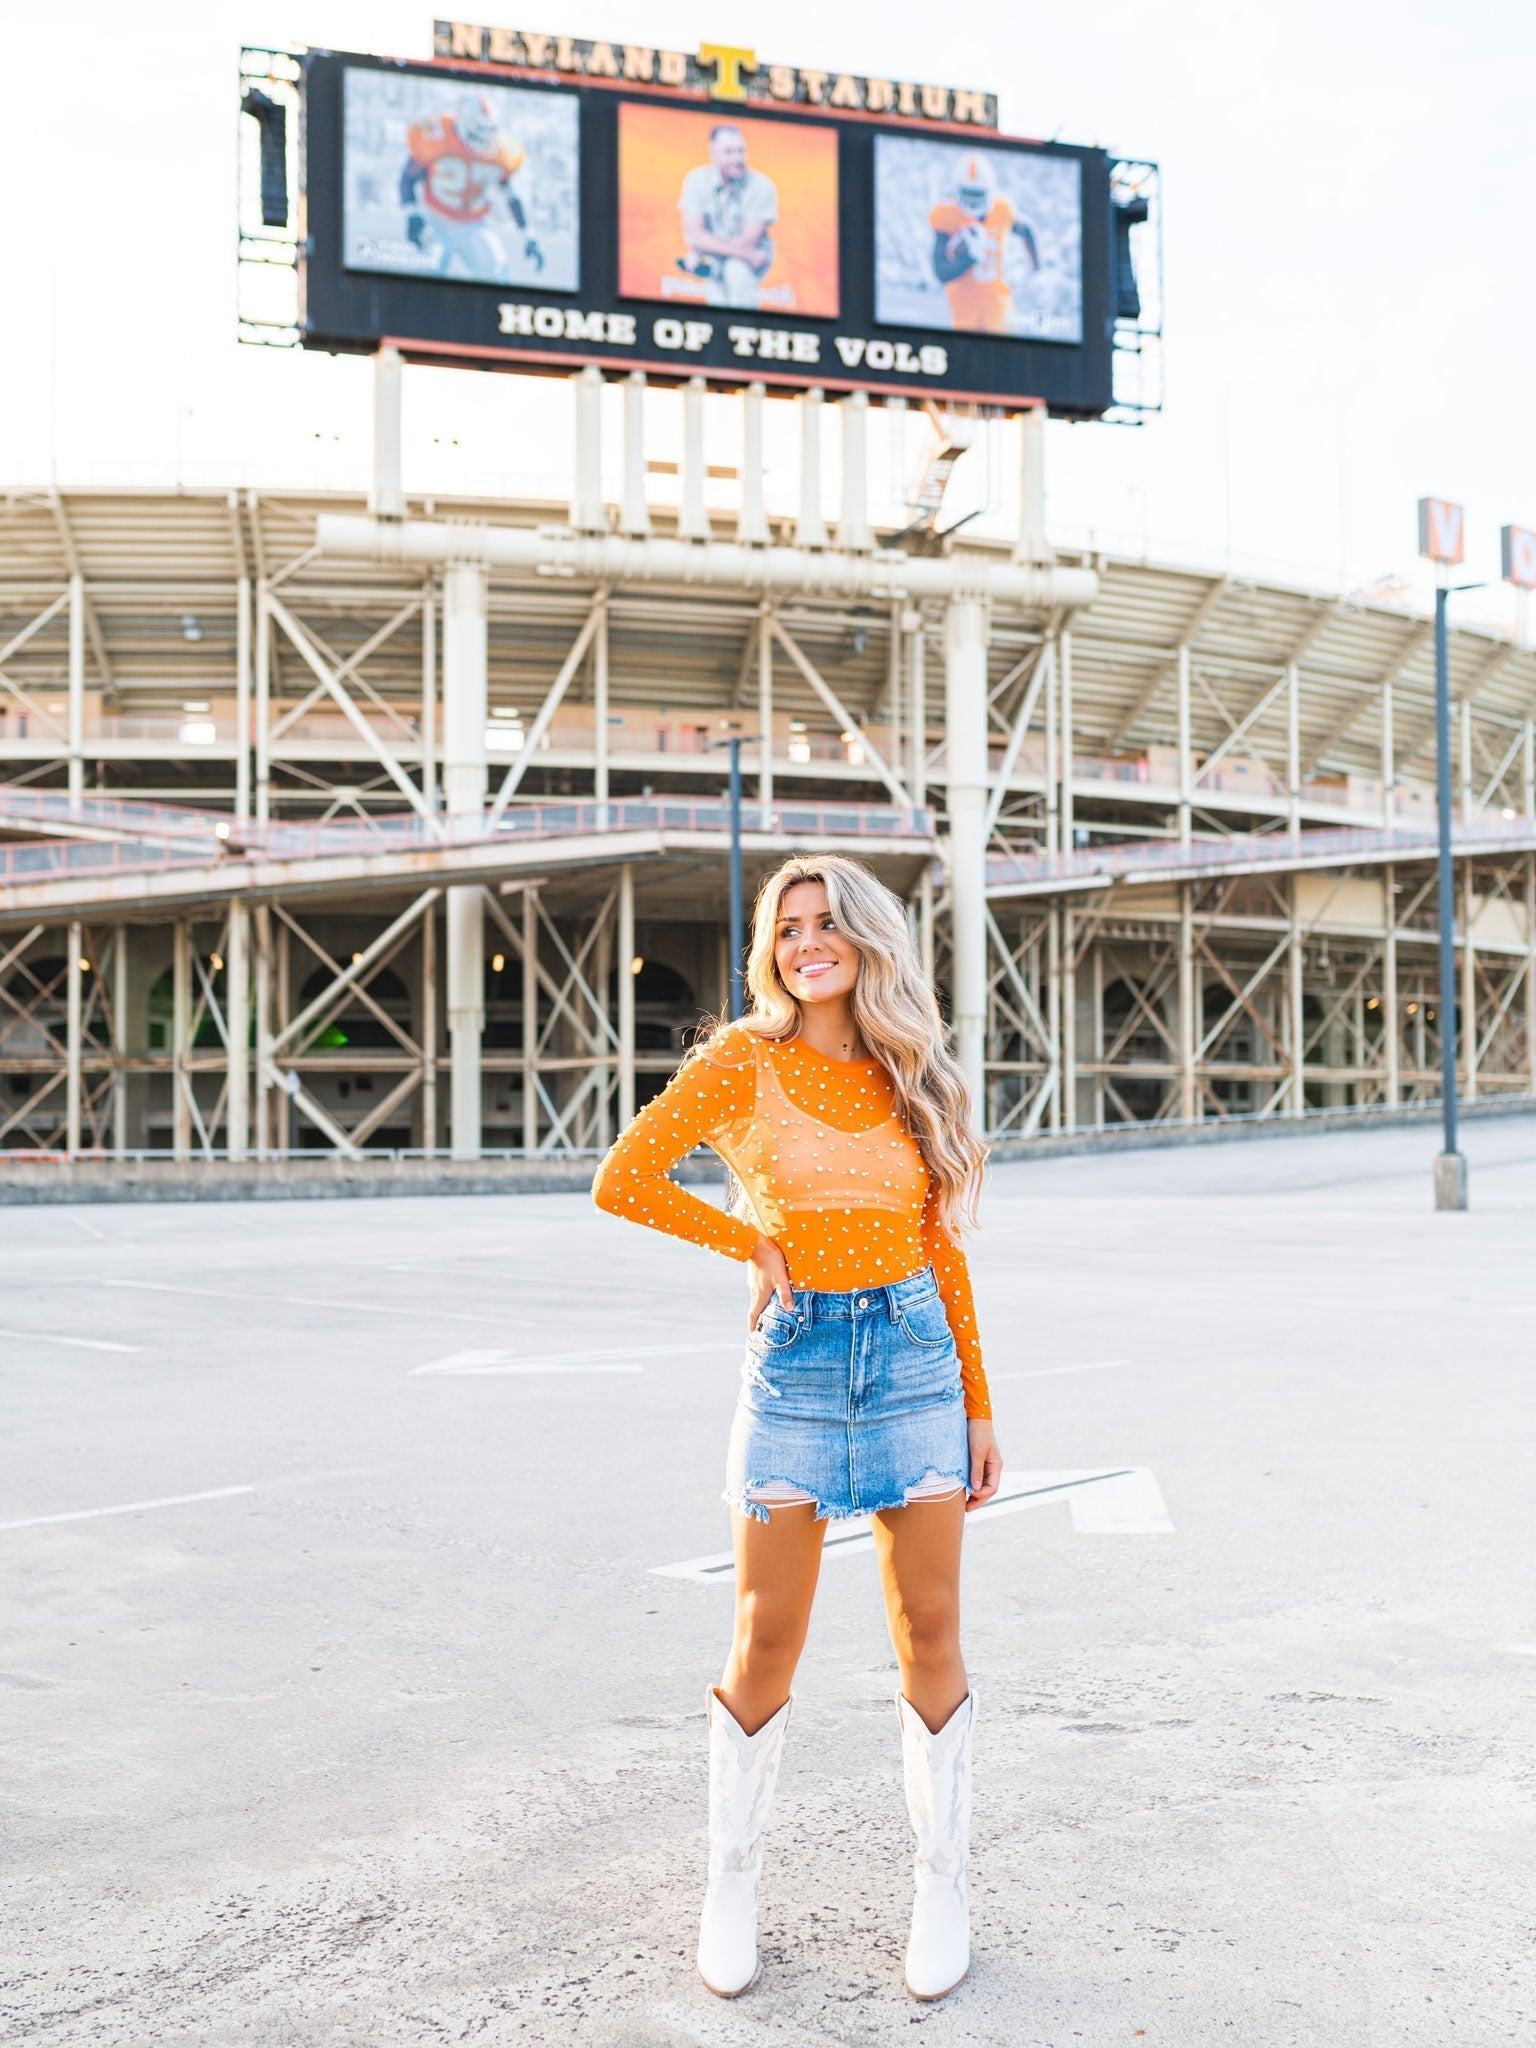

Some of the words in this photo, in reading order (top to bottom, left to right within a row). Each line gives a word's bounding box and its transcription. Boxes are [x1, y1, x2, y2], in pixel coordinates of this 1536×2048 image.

[450, 23, 688, 84] NEYLAND
[698, 43, 758, 99] T
[768, 66, 988, 123] STADIUM
[498, 303, 636, 346] HOME
[653, 318, 714, 351] OF
[728, 325, 820, 362] THE
[834, 336, 948, 376] VOLS
[1431, 501, 1461, 557] V
